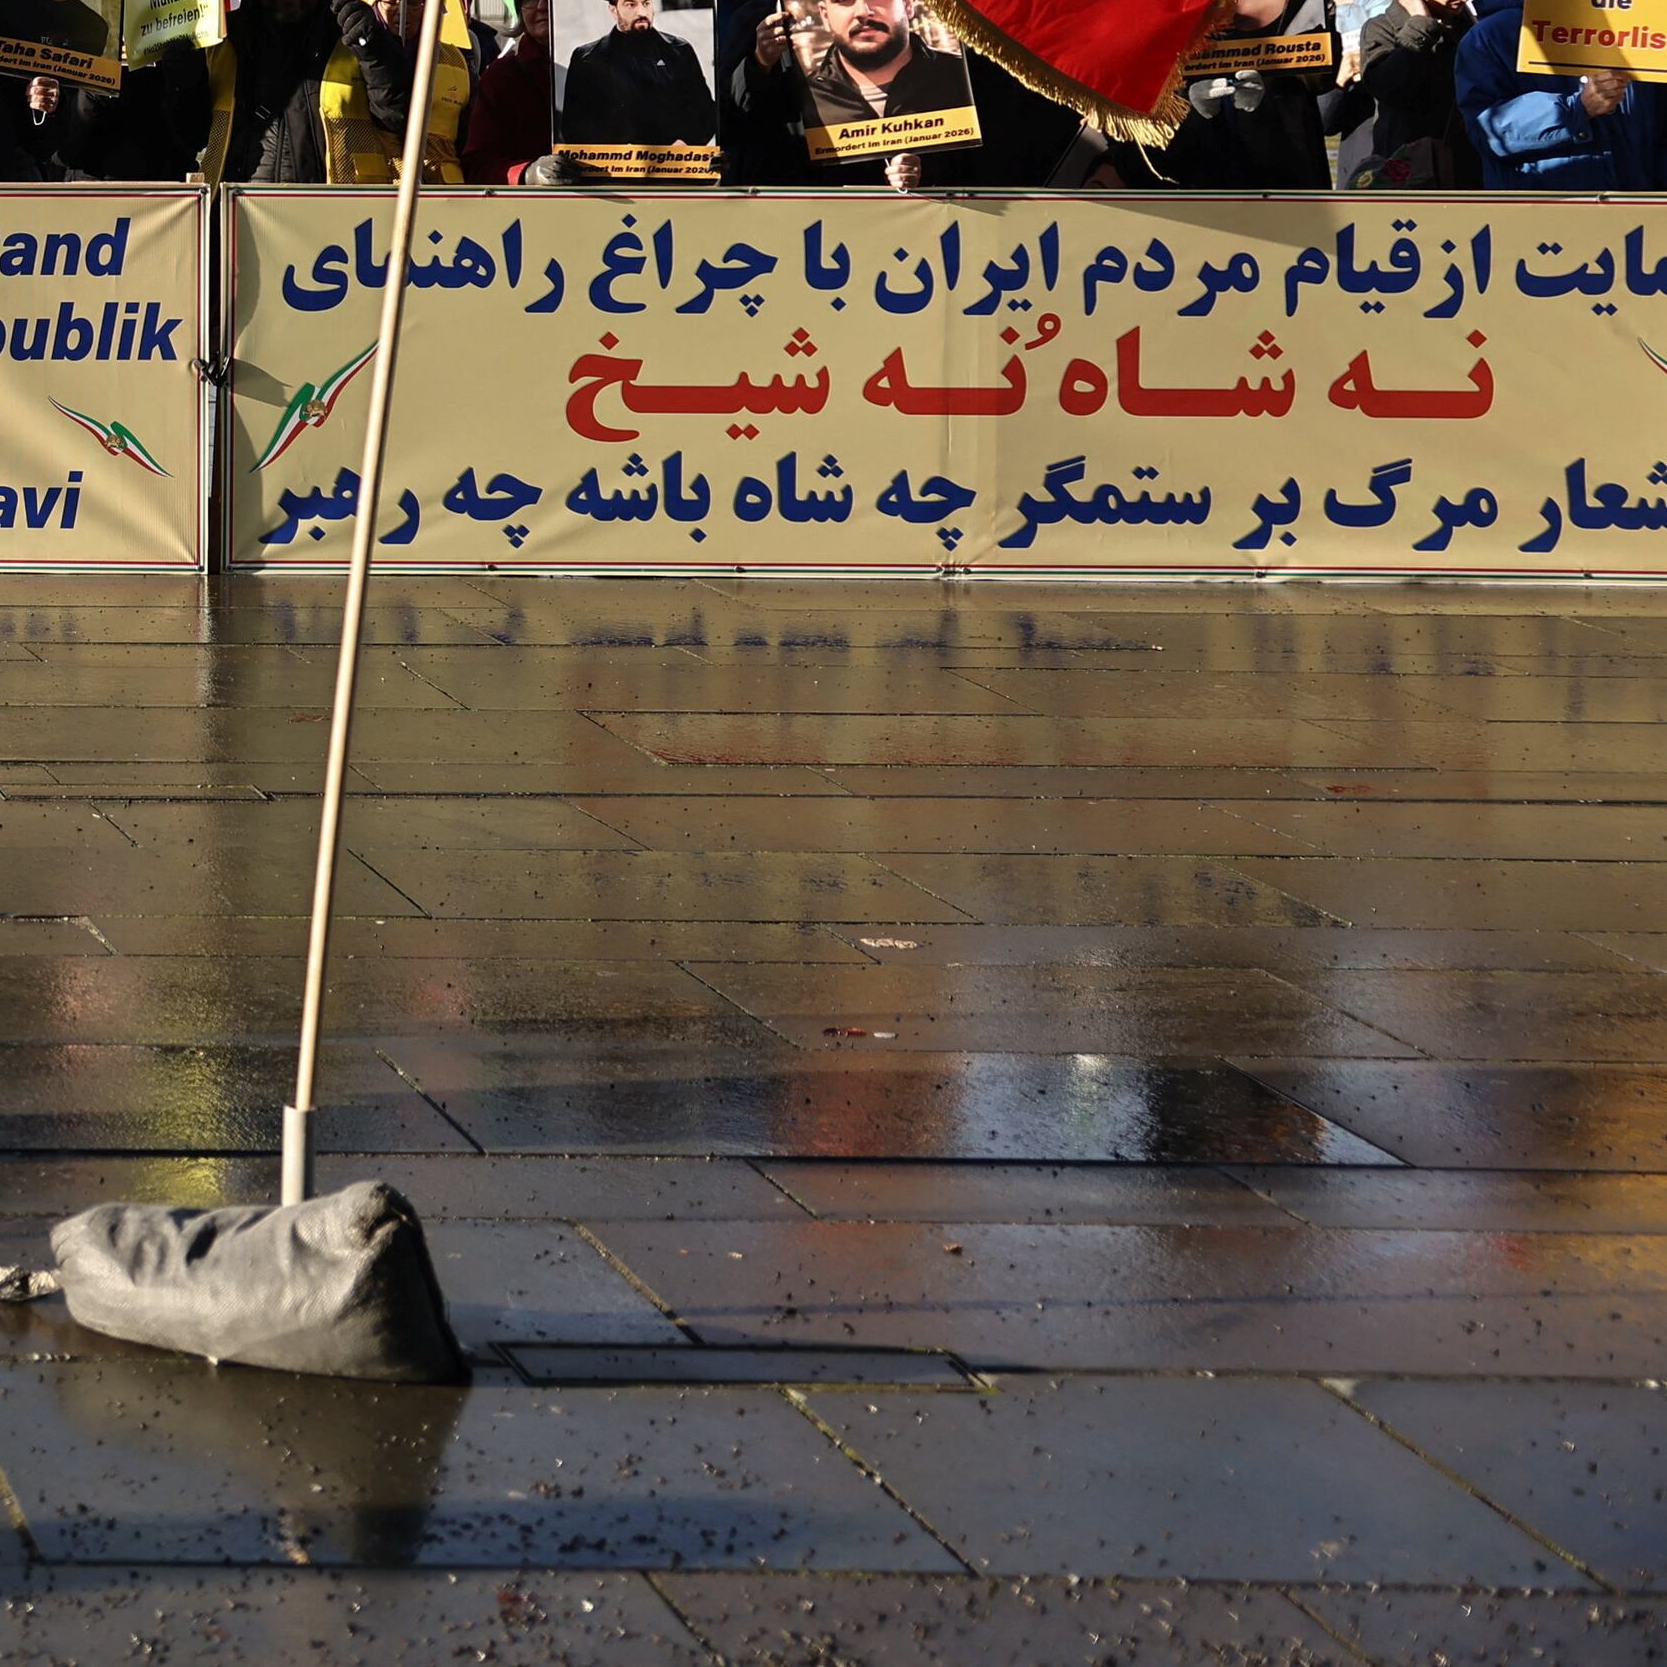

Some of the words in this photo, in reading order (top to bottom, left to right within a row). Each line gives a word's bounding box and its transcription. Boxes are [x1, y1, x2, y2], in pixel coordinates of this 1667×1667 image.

[40, 48, 94, 69] Safari
[141, 20, 153, 37] zu
[1257, 57, 1294, 67] (Januar
[1296, 54, 1325, 63] 2026)
[1264, 41, 1321, 55] Rousta
[1532, 20, 1666, 49] Terrorlis
[53, 64, 88, 78] (Januar
[89, 73, 116, 85] 2026)
[559, 150, 632, 161] Mohammd
[815, 142, 866, 155] Ermordert
[905, 134, 941, 145] (Januar
[944, 128, 974, 138] 2026)
[839, 125, 877, 140] Amir
[881, 117, 944, 134] Kuhkan
[647, 166, 683, 174] (Januar
[587, 213, 780, 318] چراغ
[802, 218, 851, 312] با
[874, 219, 1060, 316] ایران
[1083, 237, 1262, 318] مردم
[1285, 217, 1424, 318] قیام
[1423, 222, 1494, 319] از
[565, 327, 831, 443] شیخ
[442, 465, 544, 549] چه
[566, 450, 712, 544] باشه
[733, 450, 855, 523] شاه
[876, 469, 977, 553] چه
[998, 455, 1212, 550] ستمگر
[1233, 475, 1302, 550] بر
[1323, 458, 1500, 553] مرگ
